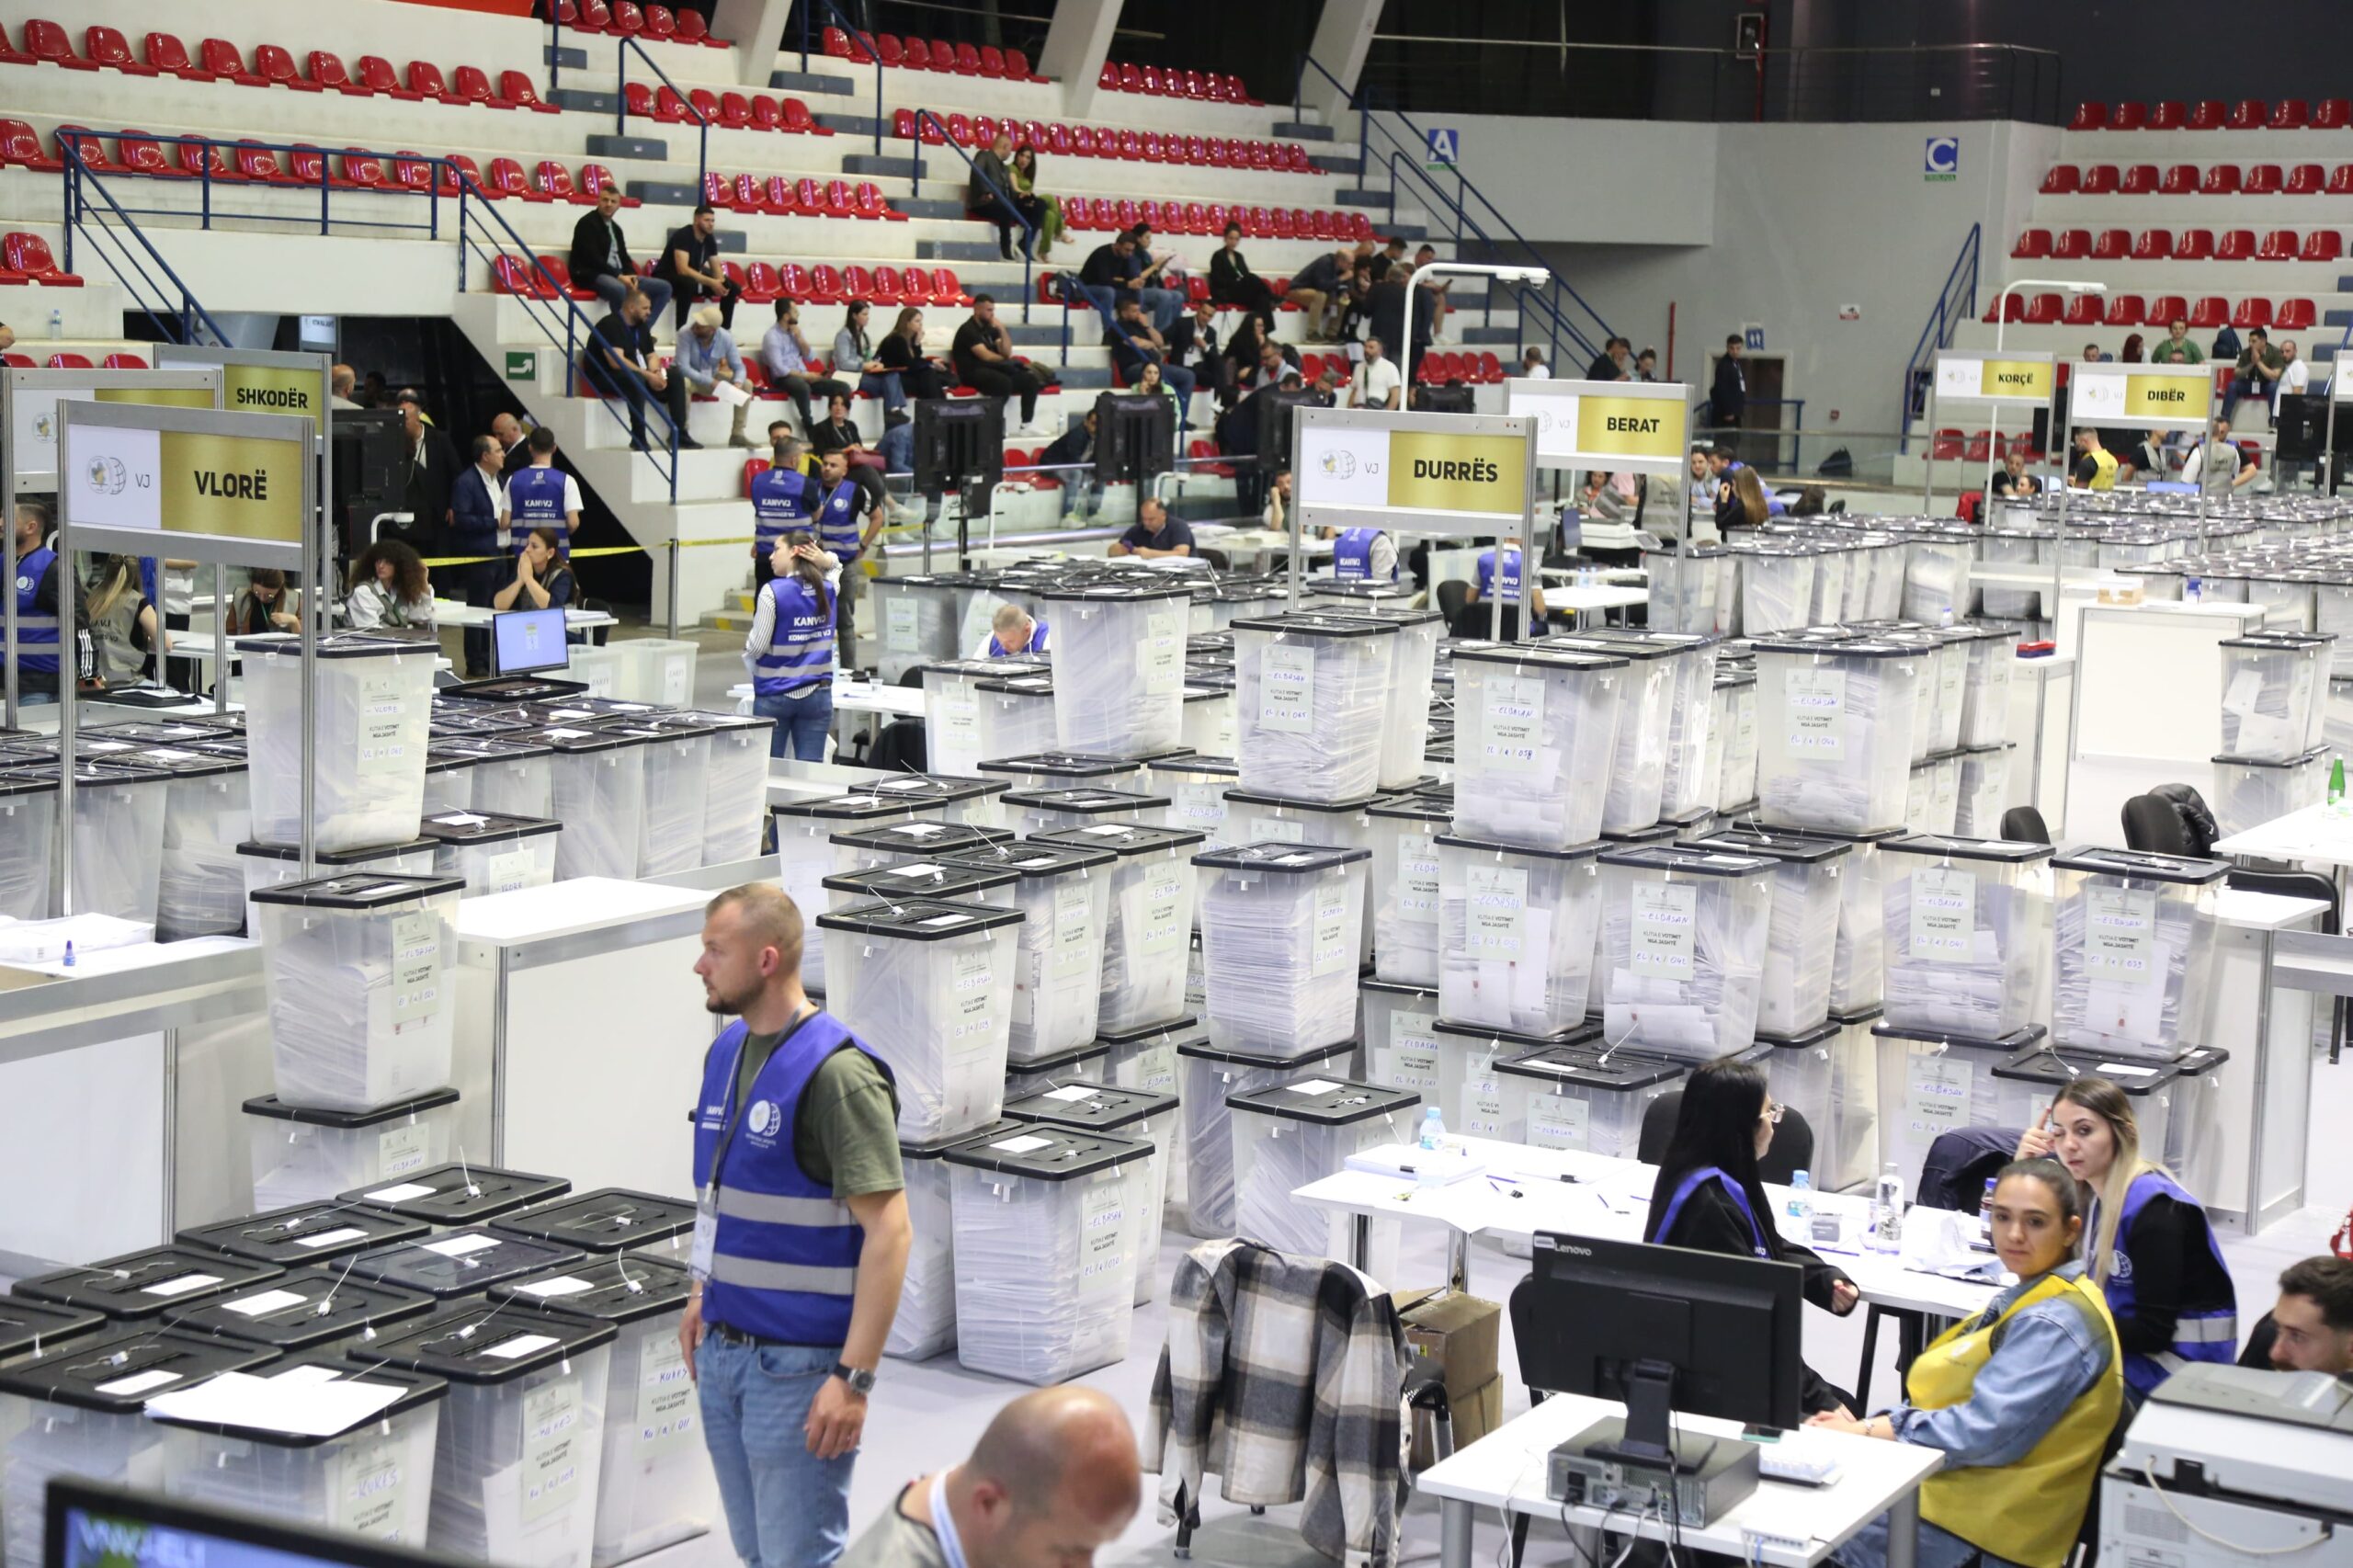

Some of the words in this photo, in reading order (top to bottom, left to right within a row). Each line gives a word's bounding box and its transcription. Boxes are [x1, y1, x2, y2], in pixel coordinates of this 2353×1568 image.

[1429, 130, 1456, 162] A
[1927, 138, 1956, 172] C
[1998, 373, 2033, 386] KORÇË
[237, 387, 308, 409] SHKODËR
[2147, 388, 2186, 402] DIBËR
[1608, 416, 1660, 433] BERAT
[1365, 462, 1379, 474] VJ
[1414, 458, 1498, 483] DURRËS
[135, 473, 151, 488] VJ
[194, 469, 267, 500] VLORË
[1554, 1242, 1592, 1256] Lenovo
